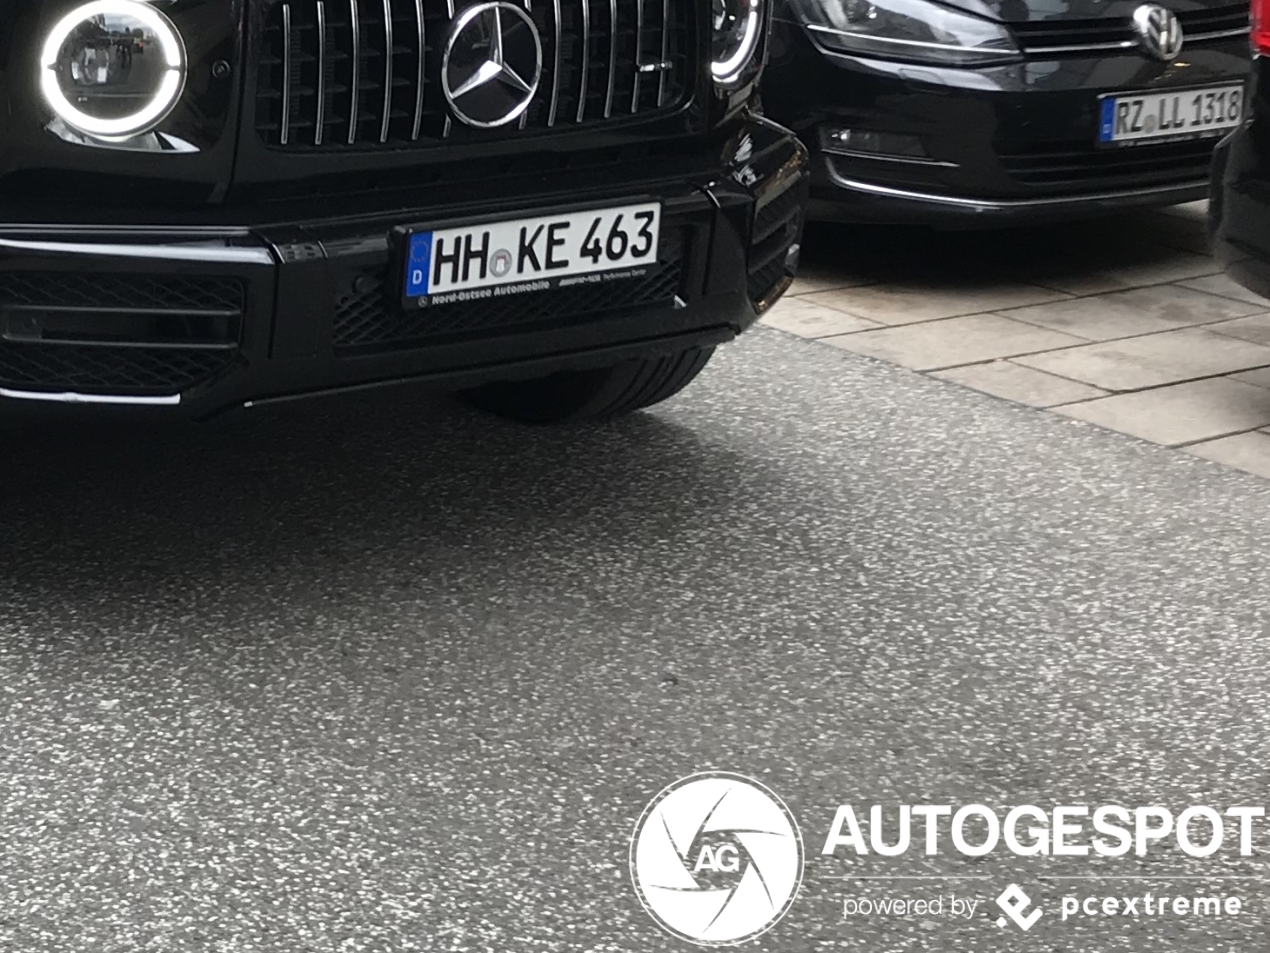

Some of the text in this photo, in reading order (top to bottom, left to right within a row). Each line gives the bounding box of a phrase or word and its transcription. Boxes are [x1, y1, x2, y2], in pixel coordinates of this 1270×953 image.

[1115, 100, 1144, 135] RZ
[1158, 97, 1185, 130] LL
[1190, 90, 1241, 127] 1318
[412, 210, 655, 286] D HH KE 463
[493, 280, 550, 297] Automobile
